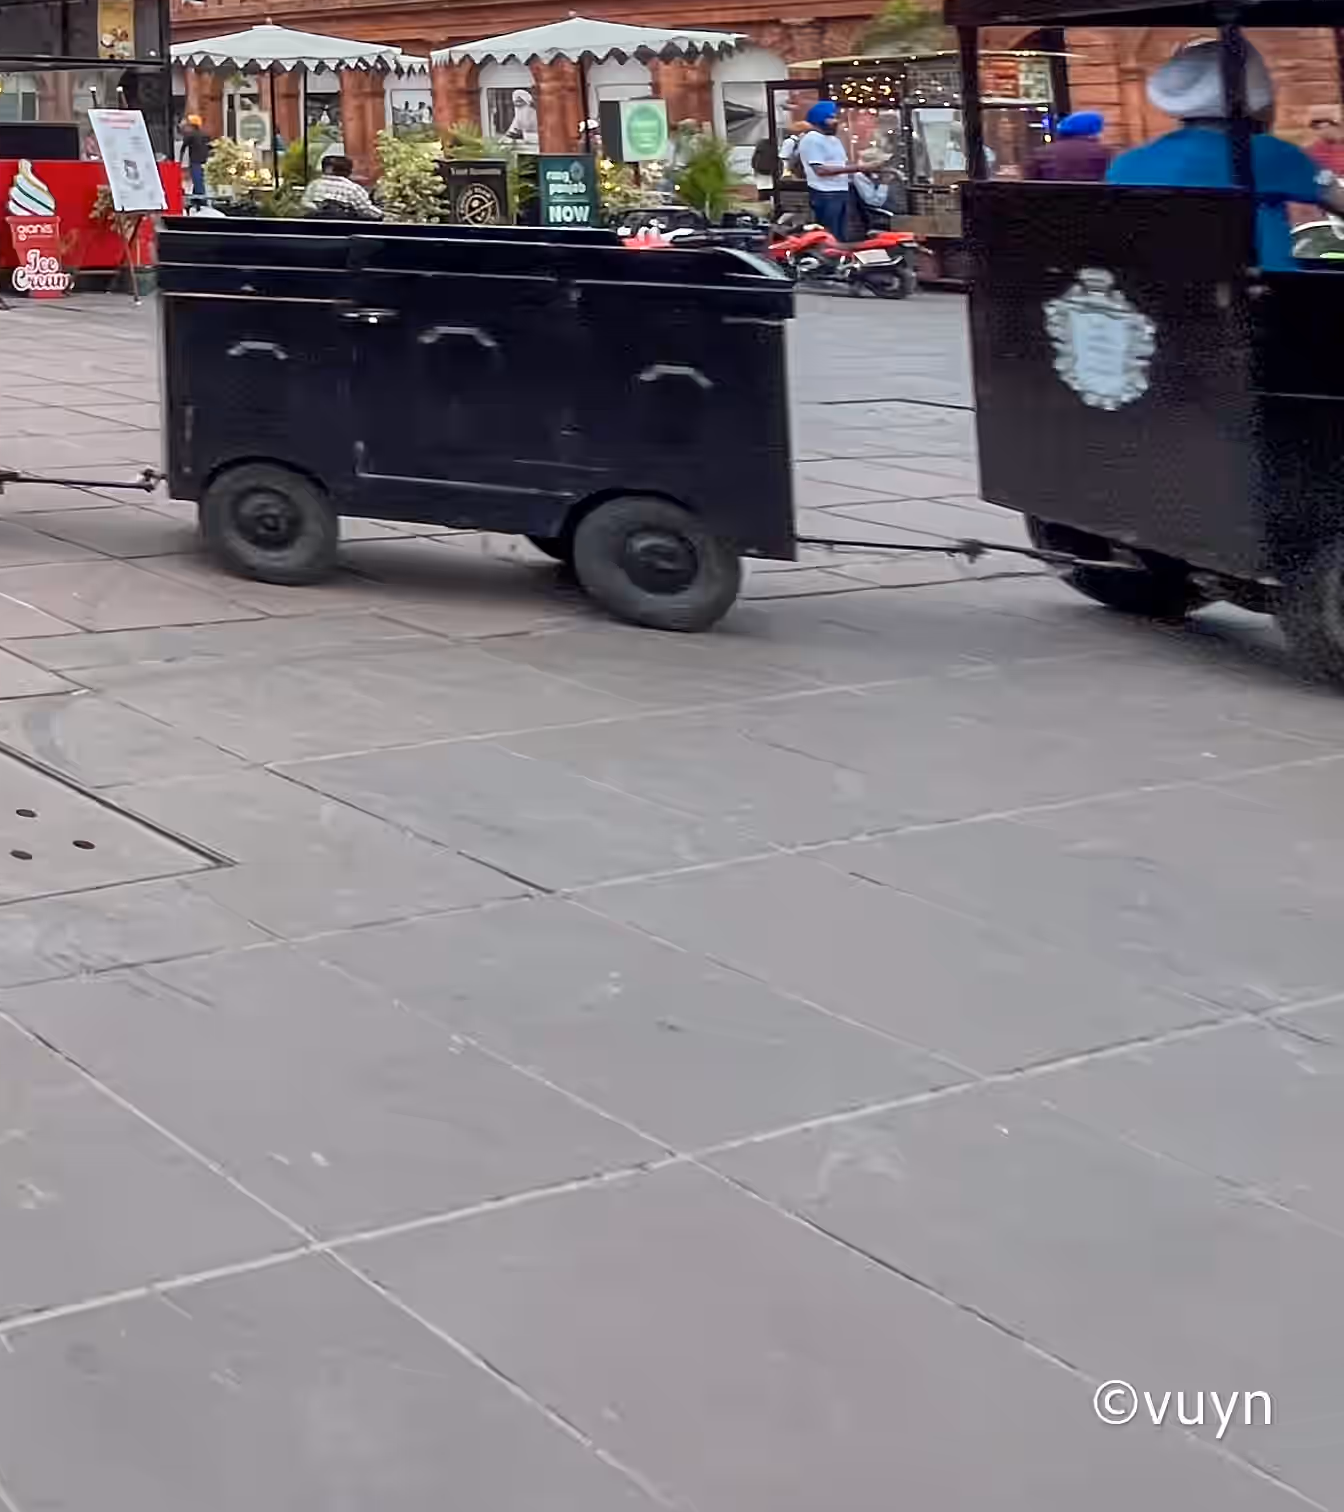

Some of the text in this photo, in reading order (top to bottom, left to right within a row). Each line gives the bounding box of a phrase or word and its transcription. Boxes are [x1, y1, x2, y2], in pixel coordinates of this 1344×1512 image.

[548, 205, 590, 224] NOW
[26, 249, 59, 273] Ice
[12, 266, 72, 291] Cream
